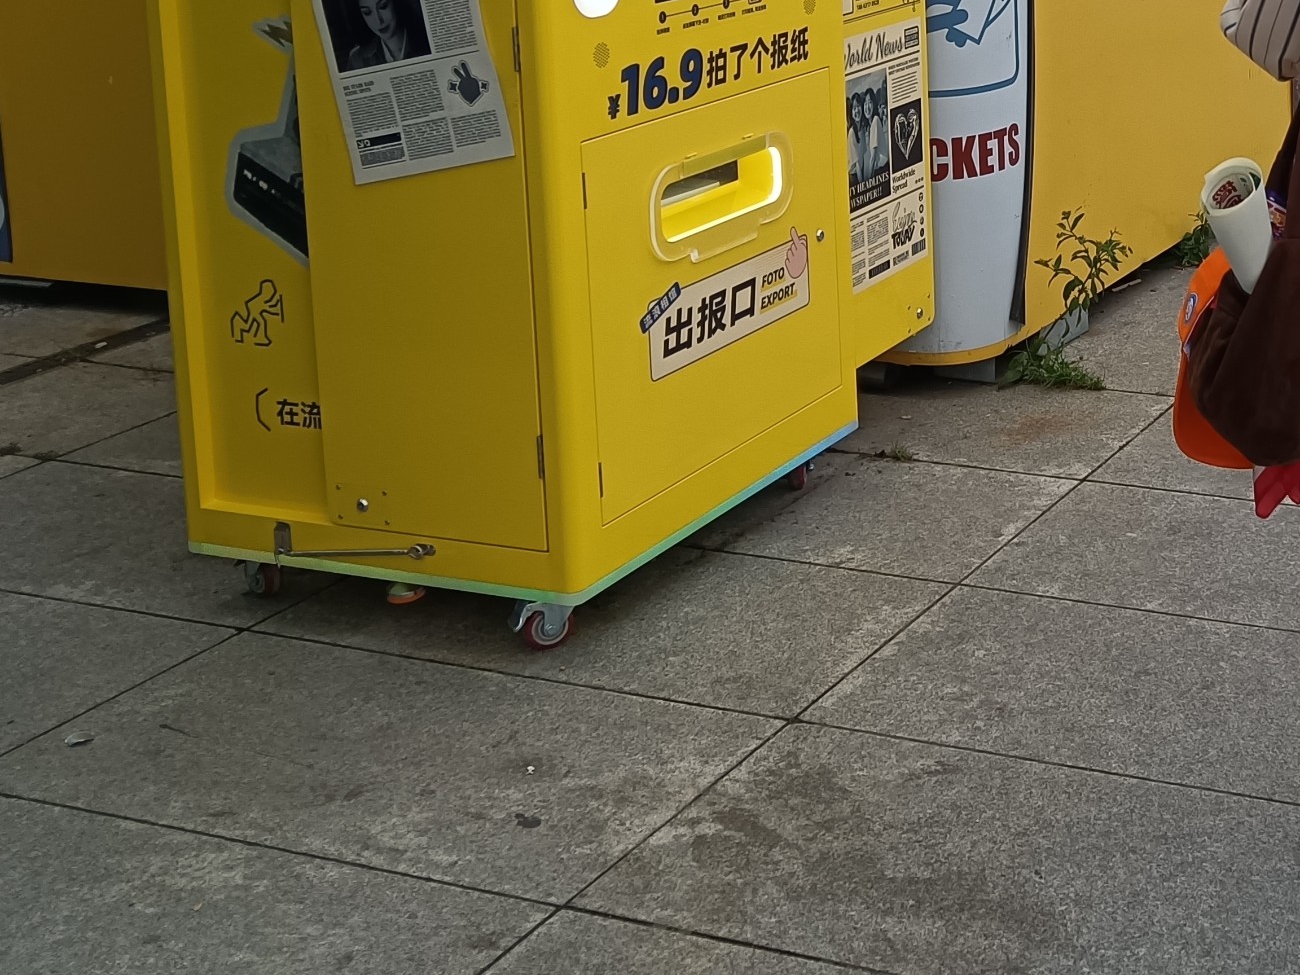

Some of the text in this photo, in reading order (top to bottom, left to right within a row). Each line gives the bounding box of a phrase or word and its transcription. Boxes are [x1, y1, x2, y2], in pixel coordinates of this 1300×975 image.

[876, 31, 903, 62] News
[929, 122, 1021, 183] CKETS
[857, 171, 890, 193] HEADLINES
[891, 168, 916, 185] Worldwide
[892, 179, 908, 194] Spread
[761, 266, 785, 289] FOTO
[760, 281, 796, 310] EXPORT
[662, 276, 757, 359] 出报口
[276, 399, 322, 430] 在流
